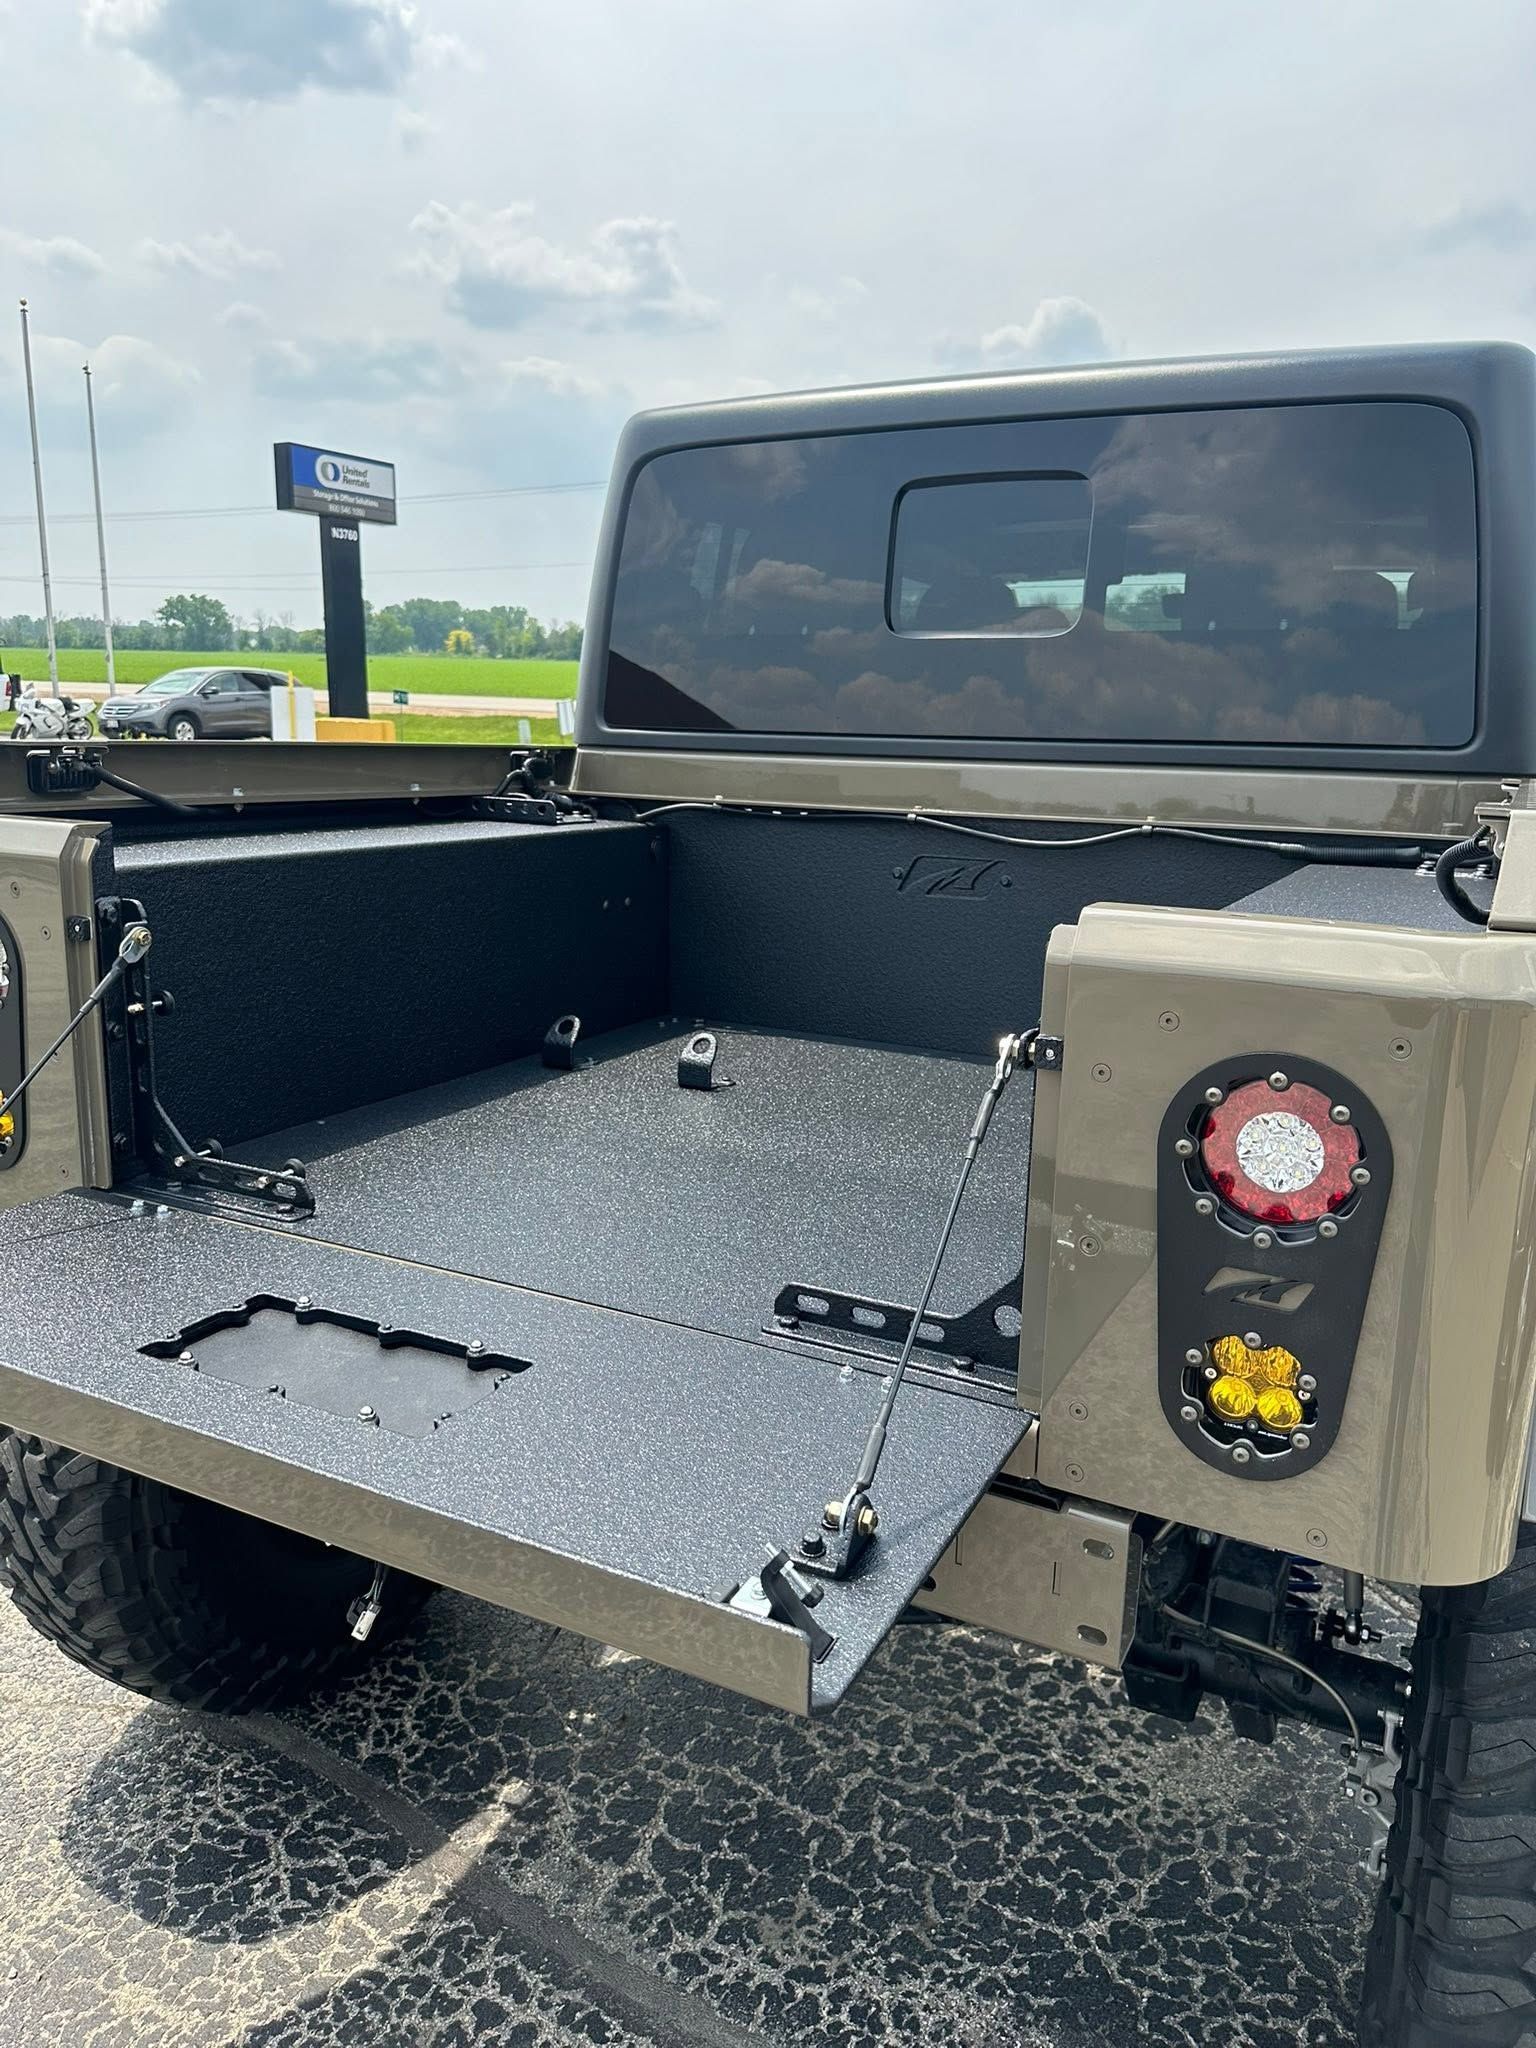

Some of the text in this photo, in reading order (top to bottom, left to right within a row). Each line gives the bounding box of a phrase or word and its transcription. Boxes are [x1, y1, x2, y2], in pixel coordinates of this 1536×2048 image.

[342, 465, 368, 478] United
[342, 475, 370, 489] Rentals
[331, 527, 358, 541] N3760
